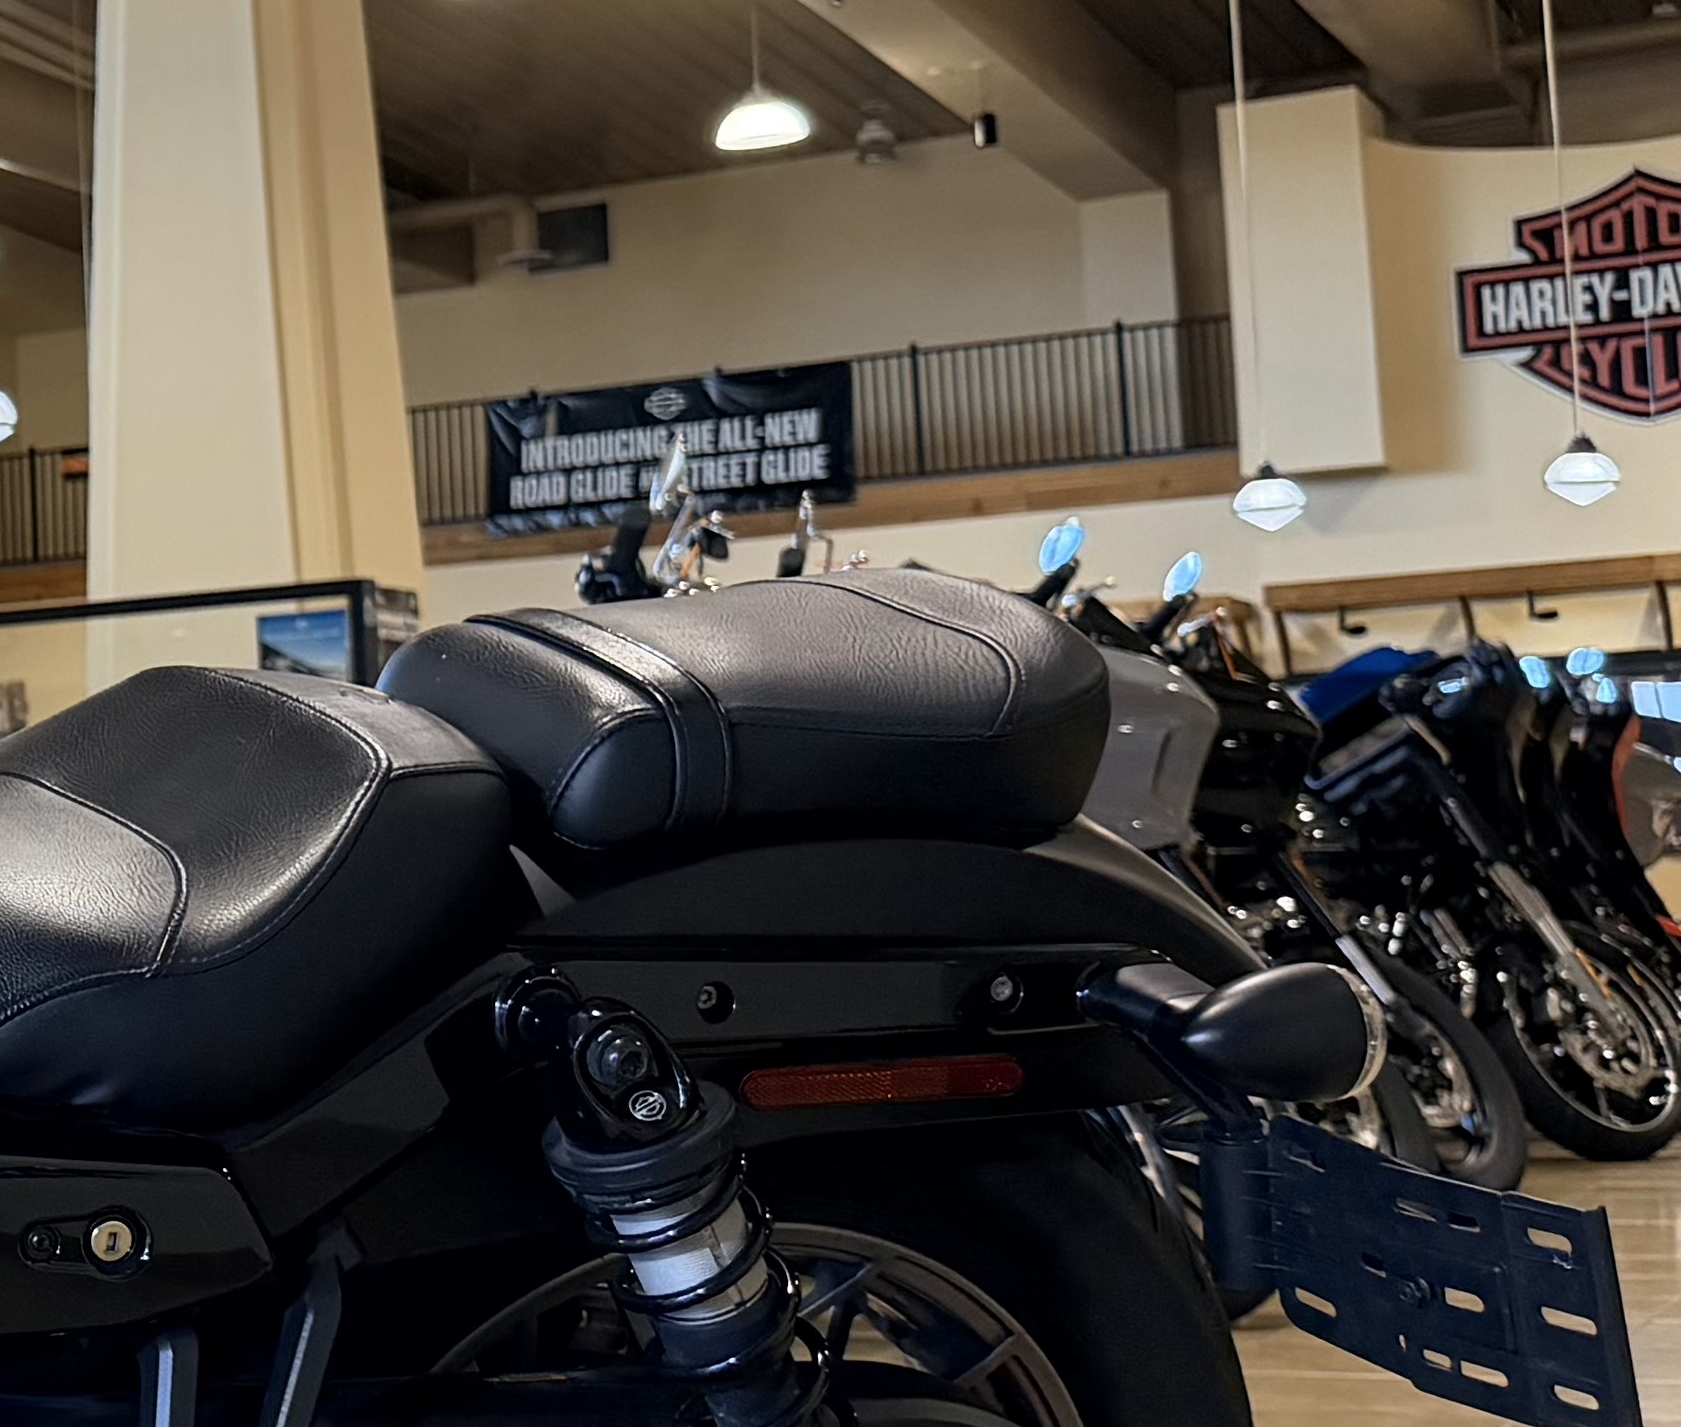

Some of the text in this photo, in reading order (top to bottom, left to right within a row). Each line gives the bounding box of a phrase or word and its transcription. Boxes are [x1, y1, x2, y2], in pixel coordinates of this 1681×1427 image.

[1480, 261, 1681, 336] HARLEY-DA
[520, 426, 671, 473] INTRODUCING
[718, 407, 821, 451] ALL-NEW
[509, 474, 567, 510] ROAD
[569, 465, 636, 504] GLIDE
[683, 453, 758, 493] TREET
[760, 443, 830, 485] GLIDE
